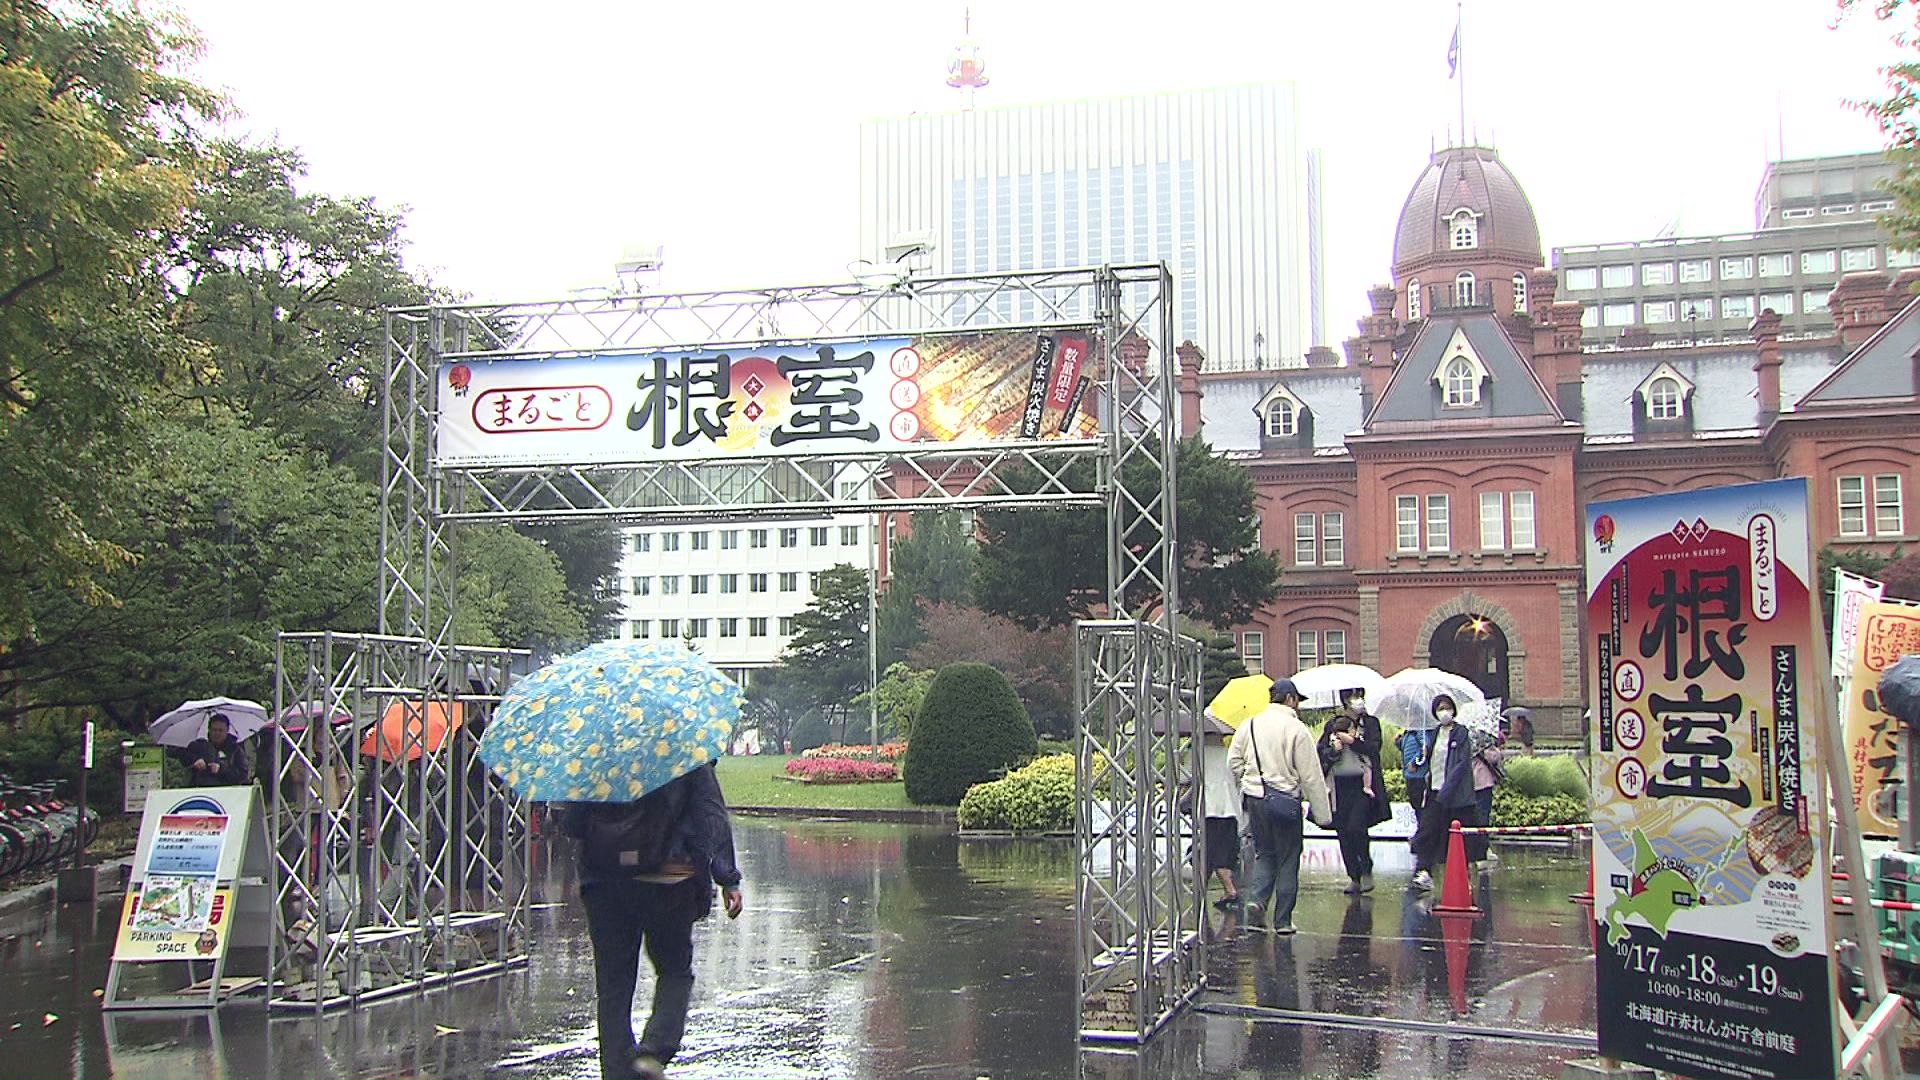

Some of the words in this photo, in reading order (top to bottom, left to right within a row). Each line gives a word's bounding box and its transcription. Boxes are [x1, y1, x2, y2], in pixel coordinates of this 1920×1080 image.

[492, 393, 592, 426] まるごと
[627, 345, 881, 449] 根室
[1024, 338, 1051, 436] さんま炭火焼き
[1053, 347, 1079, 403] 数量限定
[1754, 522, 1773, 615] まるごと
[1639, 565, 1752, 809] 根室
[1621, 668, 1639, 792] 直送市
[1775, 650, 1798, 811] さんま炭火焼き
[131, 931, 172, 942] PARKING
[156, 943, 187, 953] SPACE
[1625, 1001, 1797, 1055] 北海道庁赤れんが庁舎前庭
[1647, 979, 1721, 1006] 10:00-18:00
